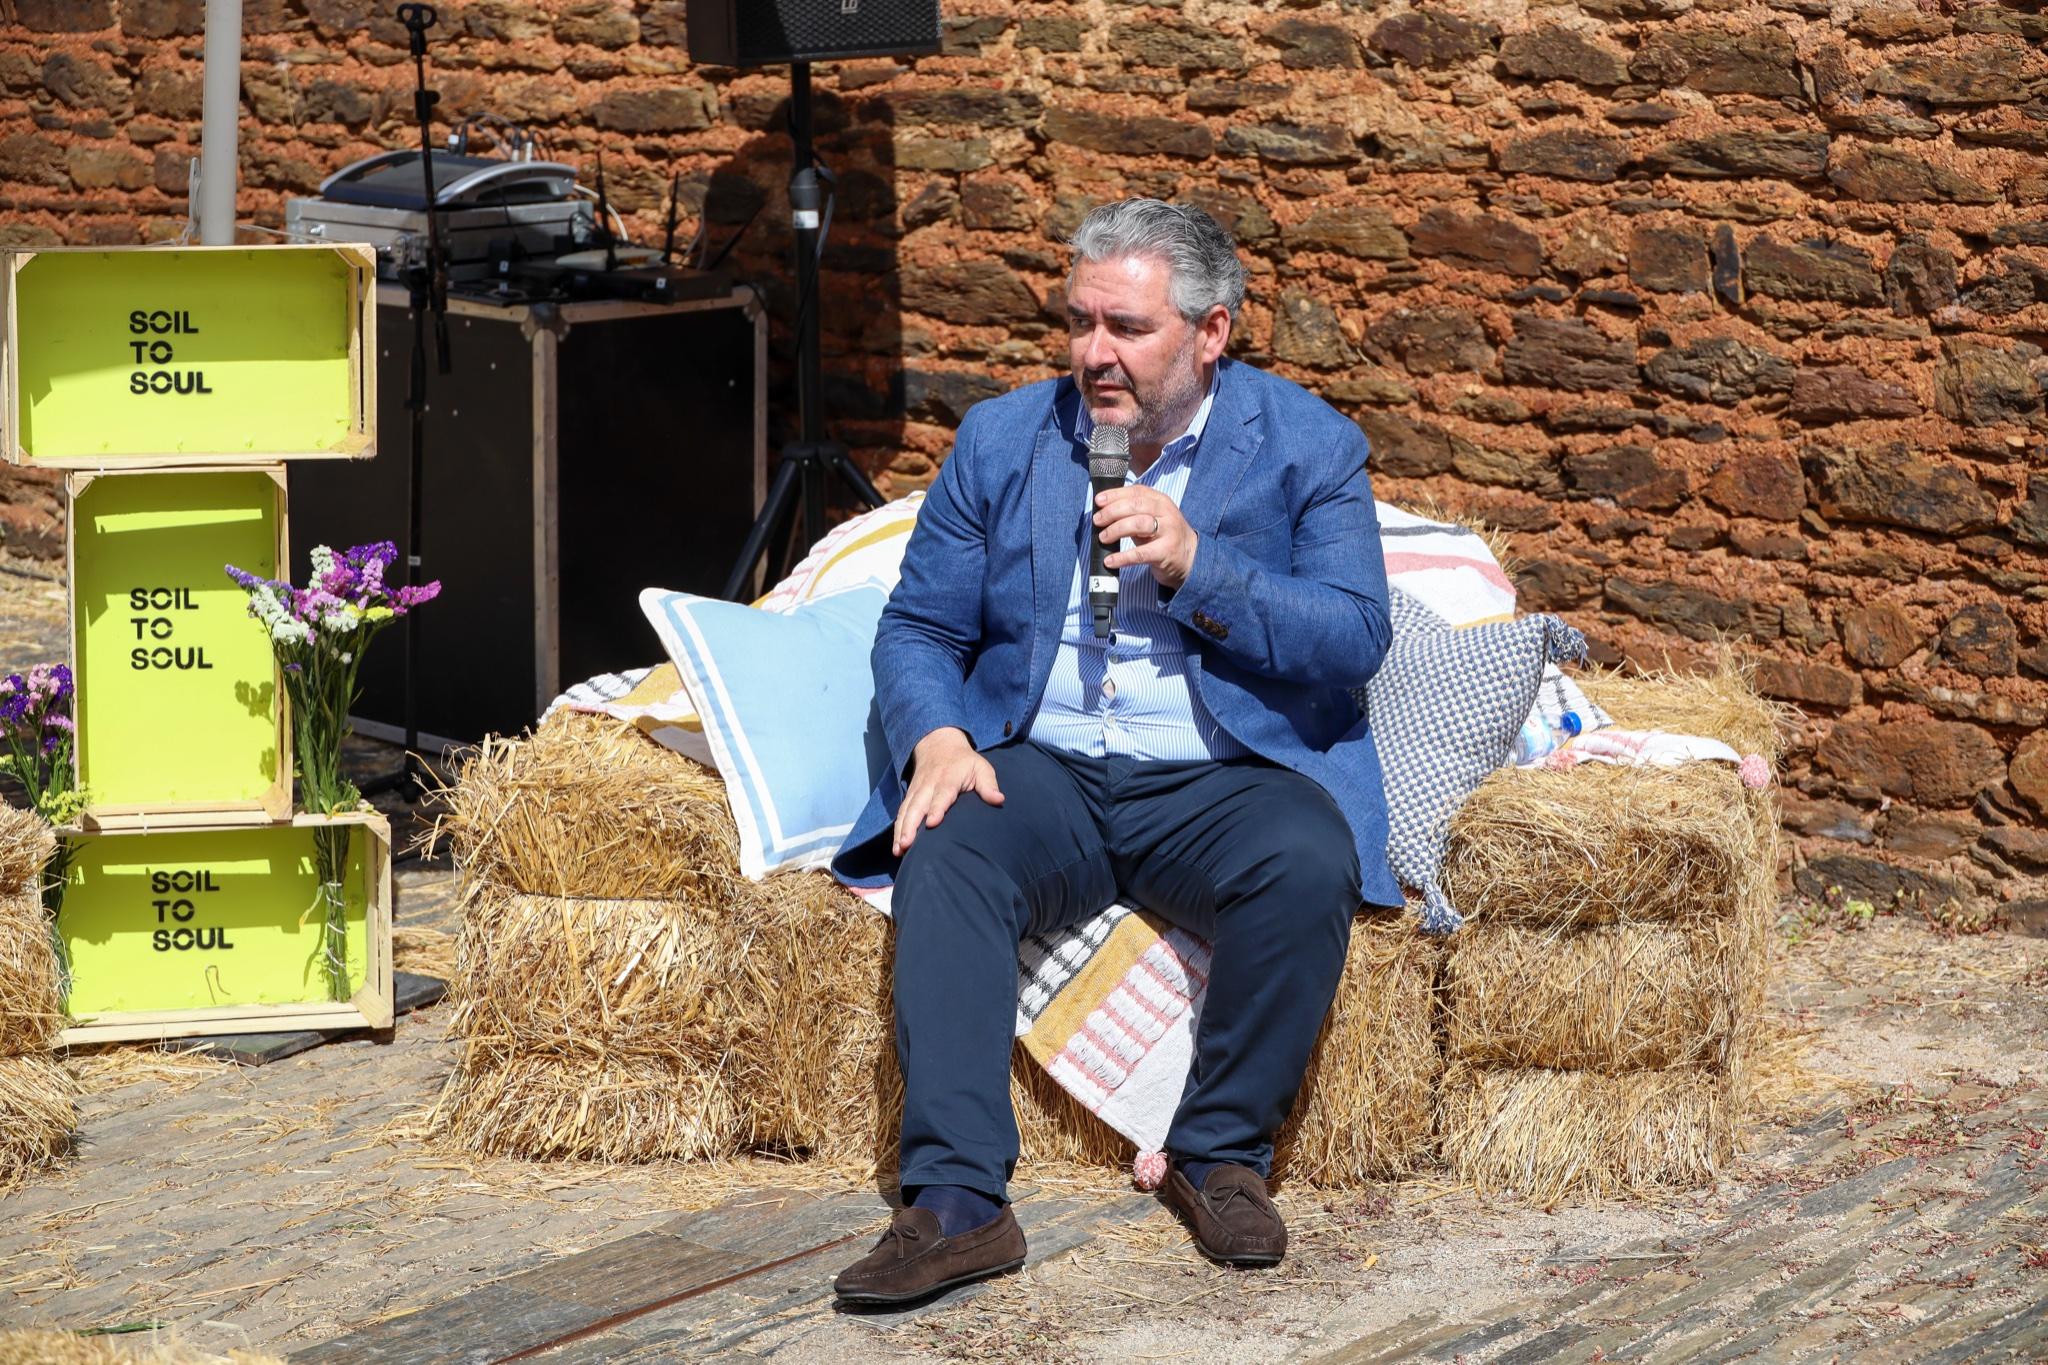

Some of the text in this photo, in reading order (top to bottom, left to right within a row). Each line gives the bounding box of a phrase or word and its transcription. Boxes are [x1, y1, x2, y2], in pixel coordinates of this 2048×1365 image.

[129, 310, 200, 335] SOIL
[129, 340, 174, 365] TO
[129, 371, 213, 395] SOUL
[130, 587, 199, 611] SOIL
[130, 617, 173, 640] TO
[130, 647, 213, 670] SOUL
[151, 870, 221, 895] SOIL
[151, 898, 195, 923] TO
[152, 927, 234, 952] SOUL
